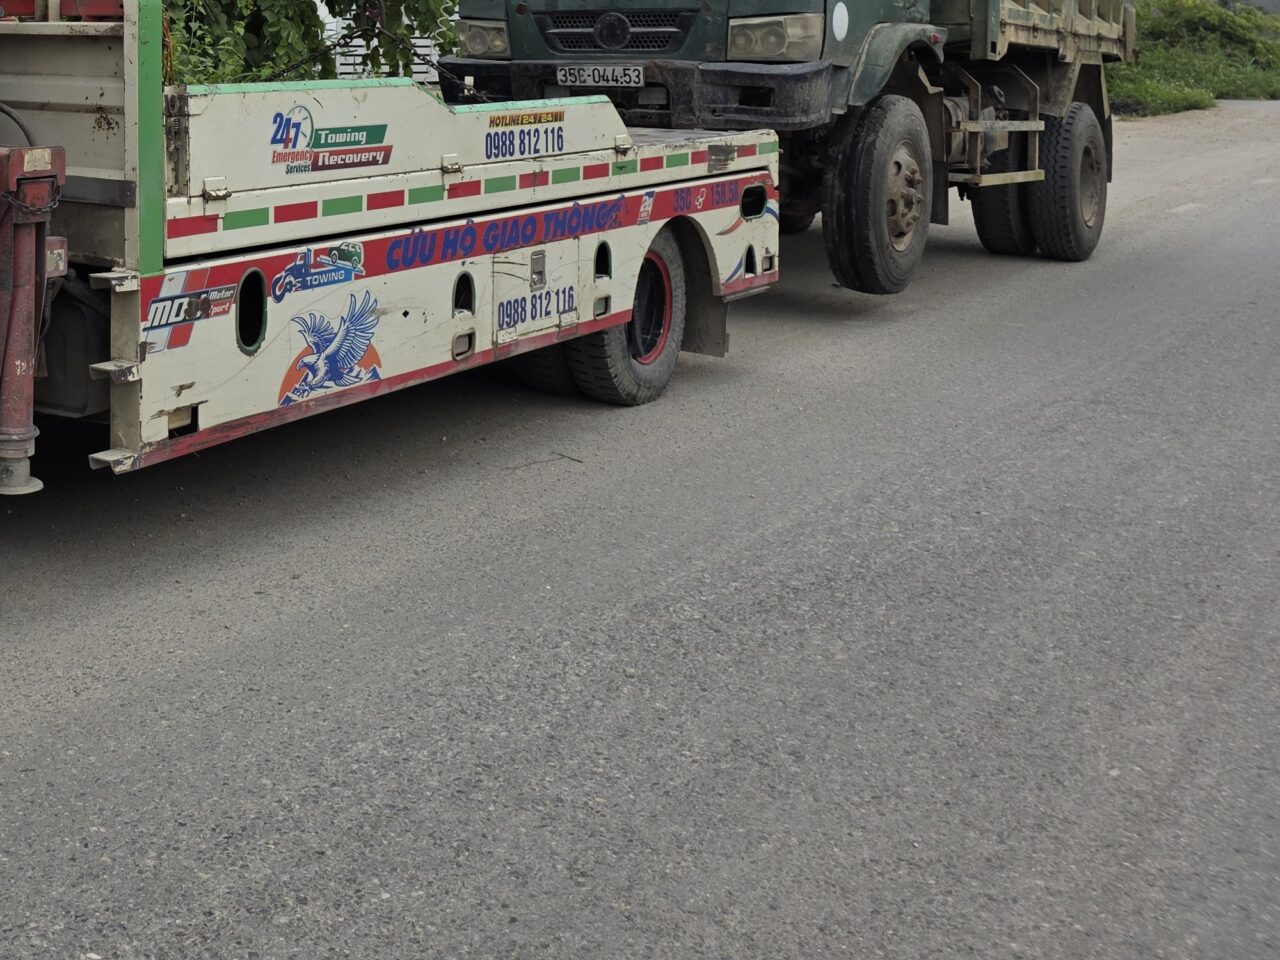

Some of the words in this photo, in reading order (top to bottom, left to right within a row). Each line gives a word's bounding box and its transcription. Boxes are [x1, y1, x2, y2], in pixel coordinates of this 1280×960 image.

[489, 114, 520, 128] HOTLINE
[318, 128, 367, 144] Towing
[486, 130, 515, 159] 0988
[519, 127, 540, 156] 812
[544, 125, 564, 153] 116
[272, 150, 313, 165] Emergency
[317, 150, 385, 167] Recovery
[286, 162, 311, 175] Services
[386, 227, 436, 271] CỨU
[441, 216, 479, 267] HỘ
[483, 216, 538, 252] GIAO
[544, 200, 613, 240] THÔNG
[306, 271, 345, 287] TOWING
[210, 289, 233, 300] Motor
[210, 302, 229, 316] port
[498, 296, 527, 330] 0988
[530, 290, 552, 323] 812
[555, 286, 575, 314] 116
